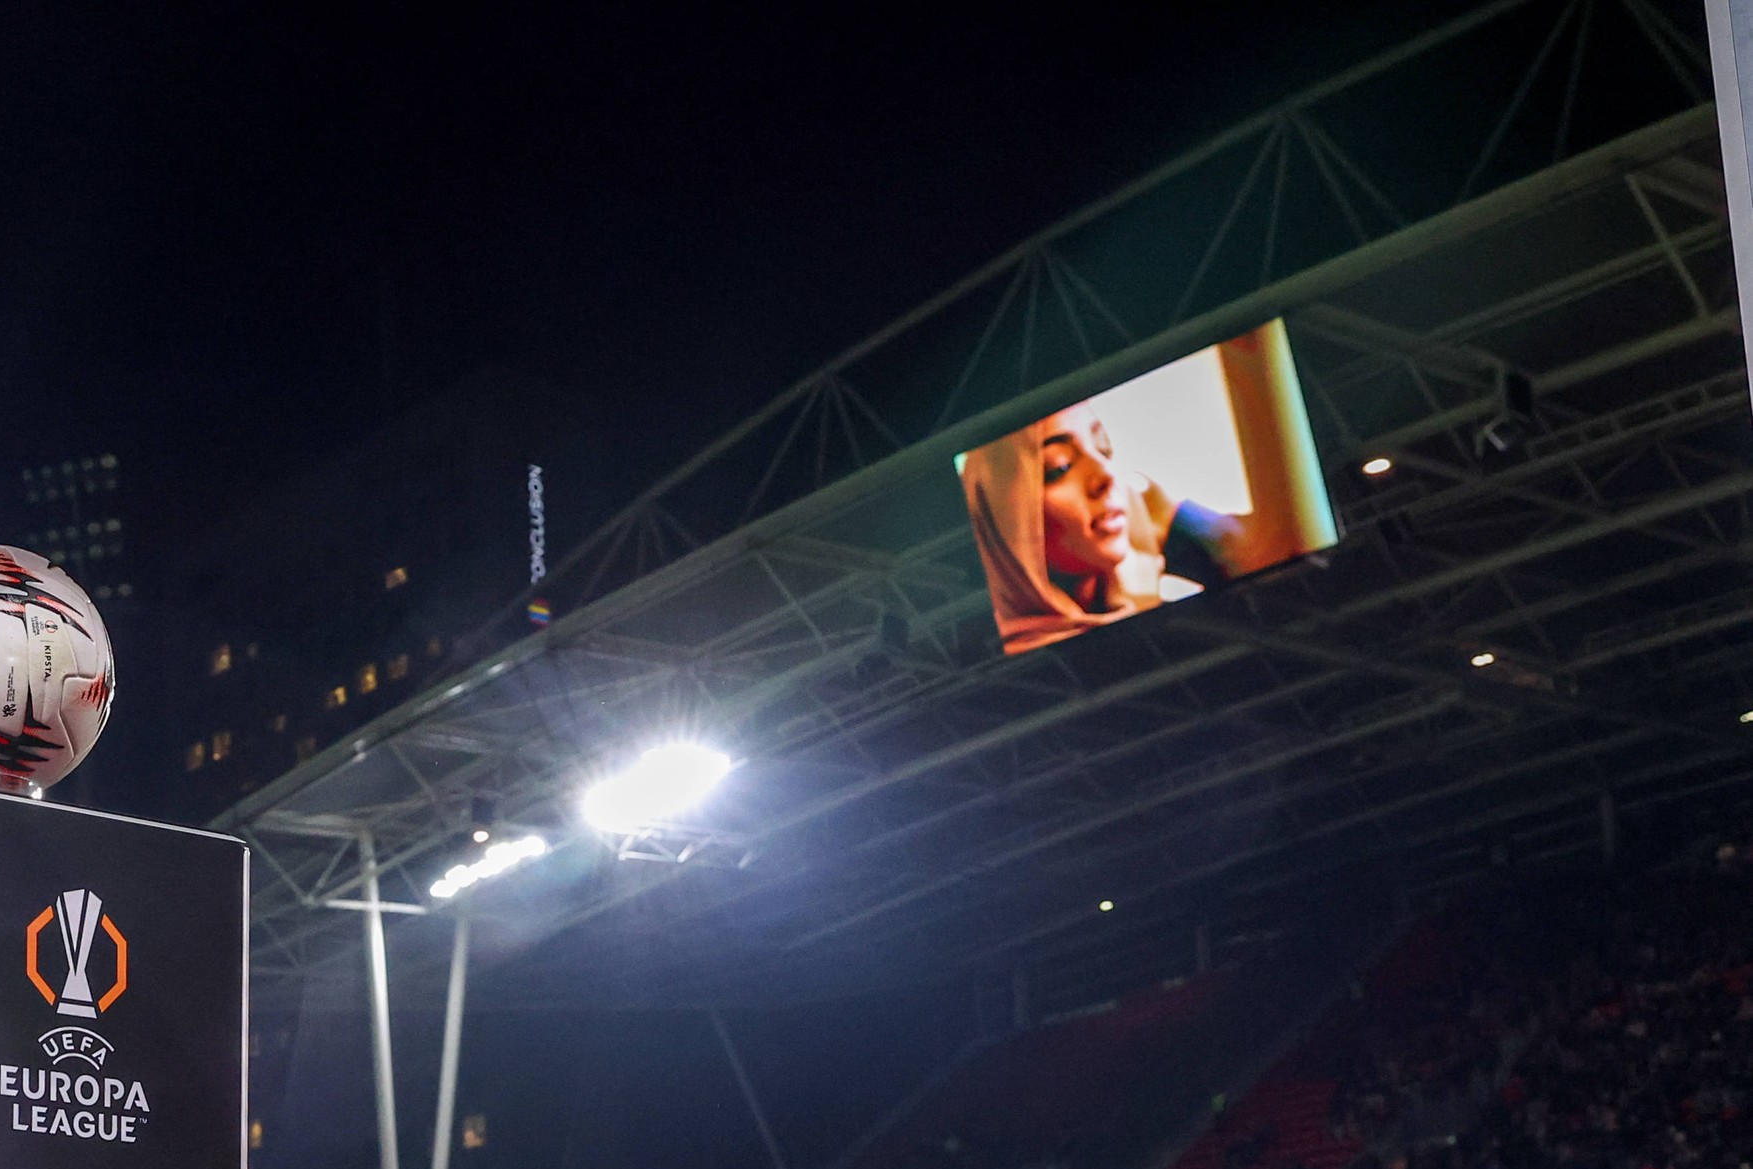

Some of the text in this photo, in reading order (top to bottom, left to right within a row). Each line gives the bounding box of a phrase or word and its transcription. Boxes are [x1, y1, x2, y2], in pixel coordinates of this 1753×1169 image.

[44, 645, 52, 678] KIPSTA
[42, 1033, 107, 1065] UEFA
[0, 1064, 151, 1112] EUROPA
[12, 1103, 136, 1143] LEAGUE
